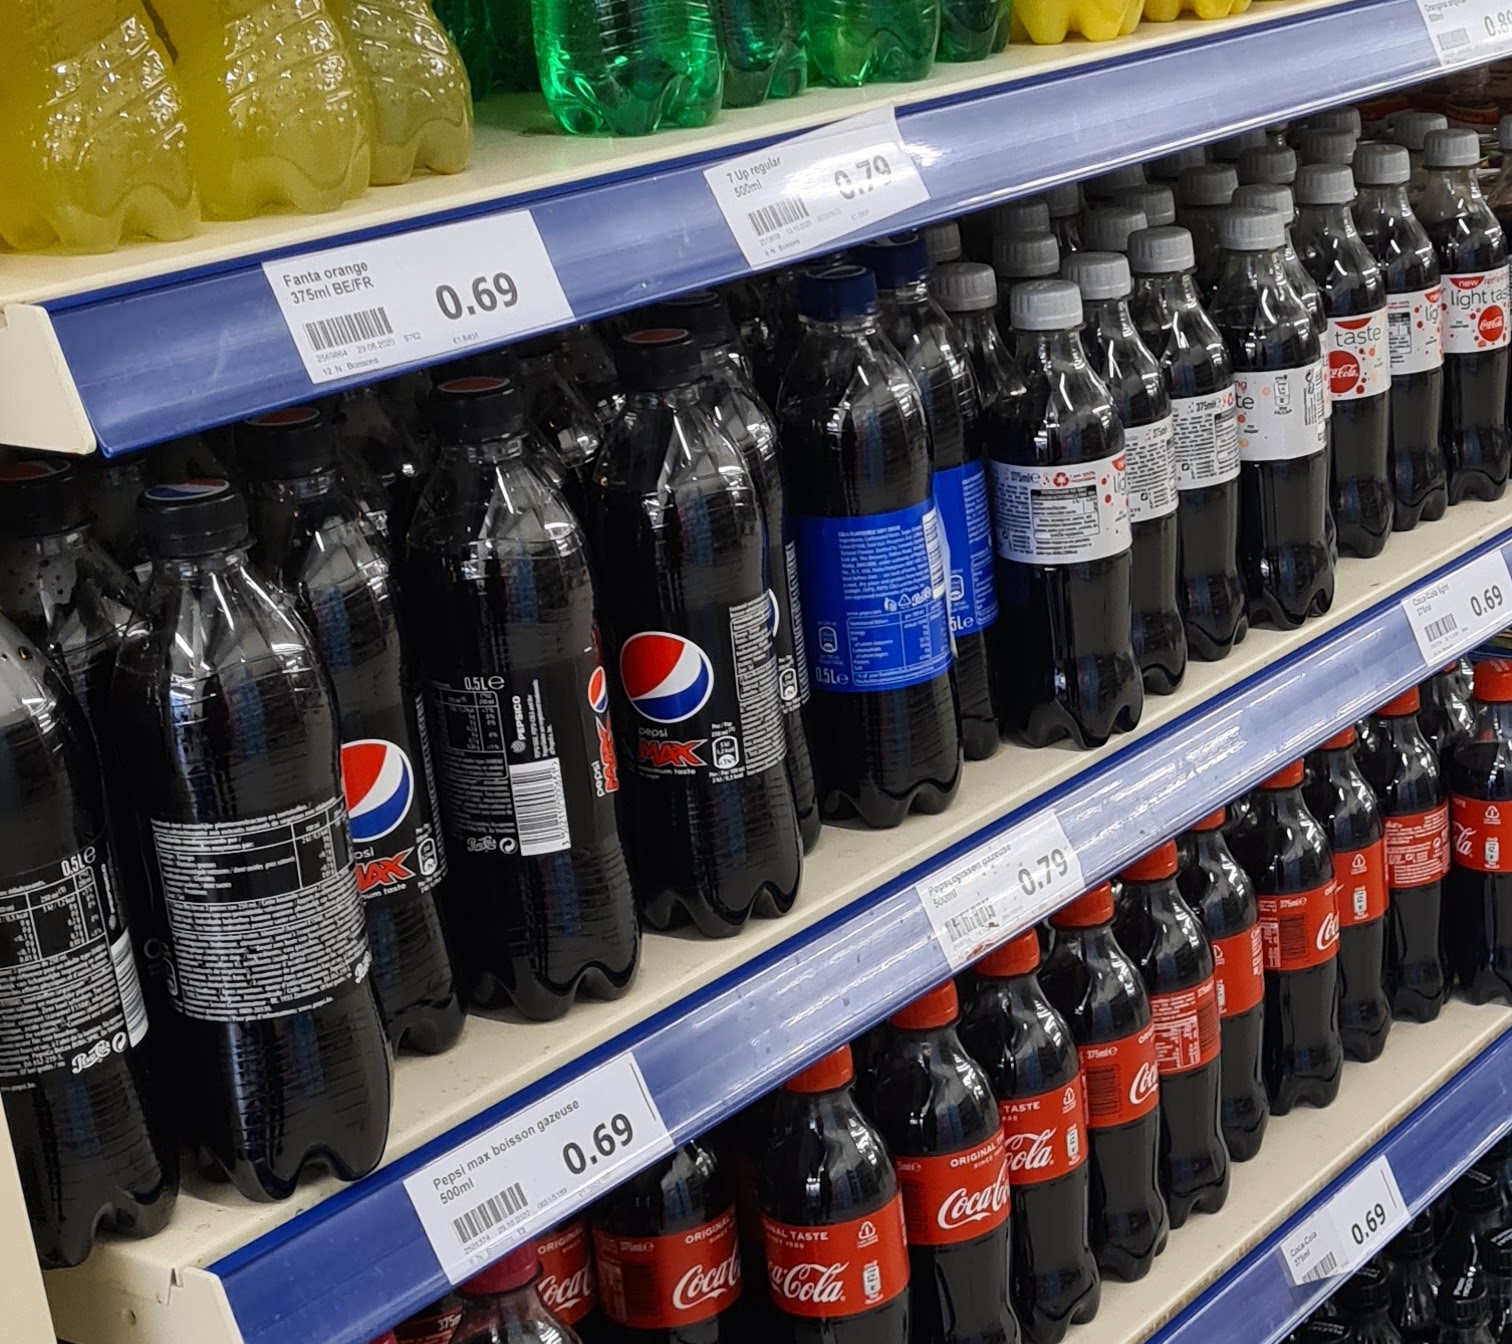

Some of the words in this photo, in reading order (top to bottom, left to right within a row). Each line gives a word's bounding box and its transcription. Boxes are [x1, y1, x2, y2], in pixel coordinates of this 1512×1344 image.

[727, 172, 735, 185] 7
[736, 167, 748, 184] Up
[750, 156, 782, 177] regular
[734, 178, 763, 199] 500ml
[282, 266, 322, 288] Fanta
[322, 260, 369, 282] orange
[1458, 278, 1480, 289] new
[289, 285, 331, 305] 375ml
[333, 275, 375, 298] BE/FR
[435, 271, 519, 321] 0.69
[1450, 289, 1483, 310] light
[1485, 288, 1510, 306] tas
[1334, 326, 1383, 348] taste
[1470, 584, 1503, 617] 0.69
[464, 675, 489, 691] 0.5L
[511, 695, 527, 741] PEPSICO
[640, 738, 709, 768] MAX
[591, 759, 606, 797] pepsi
[61, 855, 86, 877] 0.5L
[1018, 847, 1069, 897] 0.79
[382, 882, 407, 896] taste
[1004, 1101, 1041, 1115] TASTE
[432, 1163, 468, 1190] Pepsi
[466, 1151, 492, 1173] max
[491, 1123, 536, 1158] boisson
[536, 1098, 580, 1136] gazeuse
[562, 1112, 634, 1176] 0.69
[438, 1176, 475, 1205] 500ml
[789, 1231, 829, 1242] TASTE
[1350, 1202, 1386, 1246] 0.69
[1289, 1231, 1318, 1256] Coca-Cola
